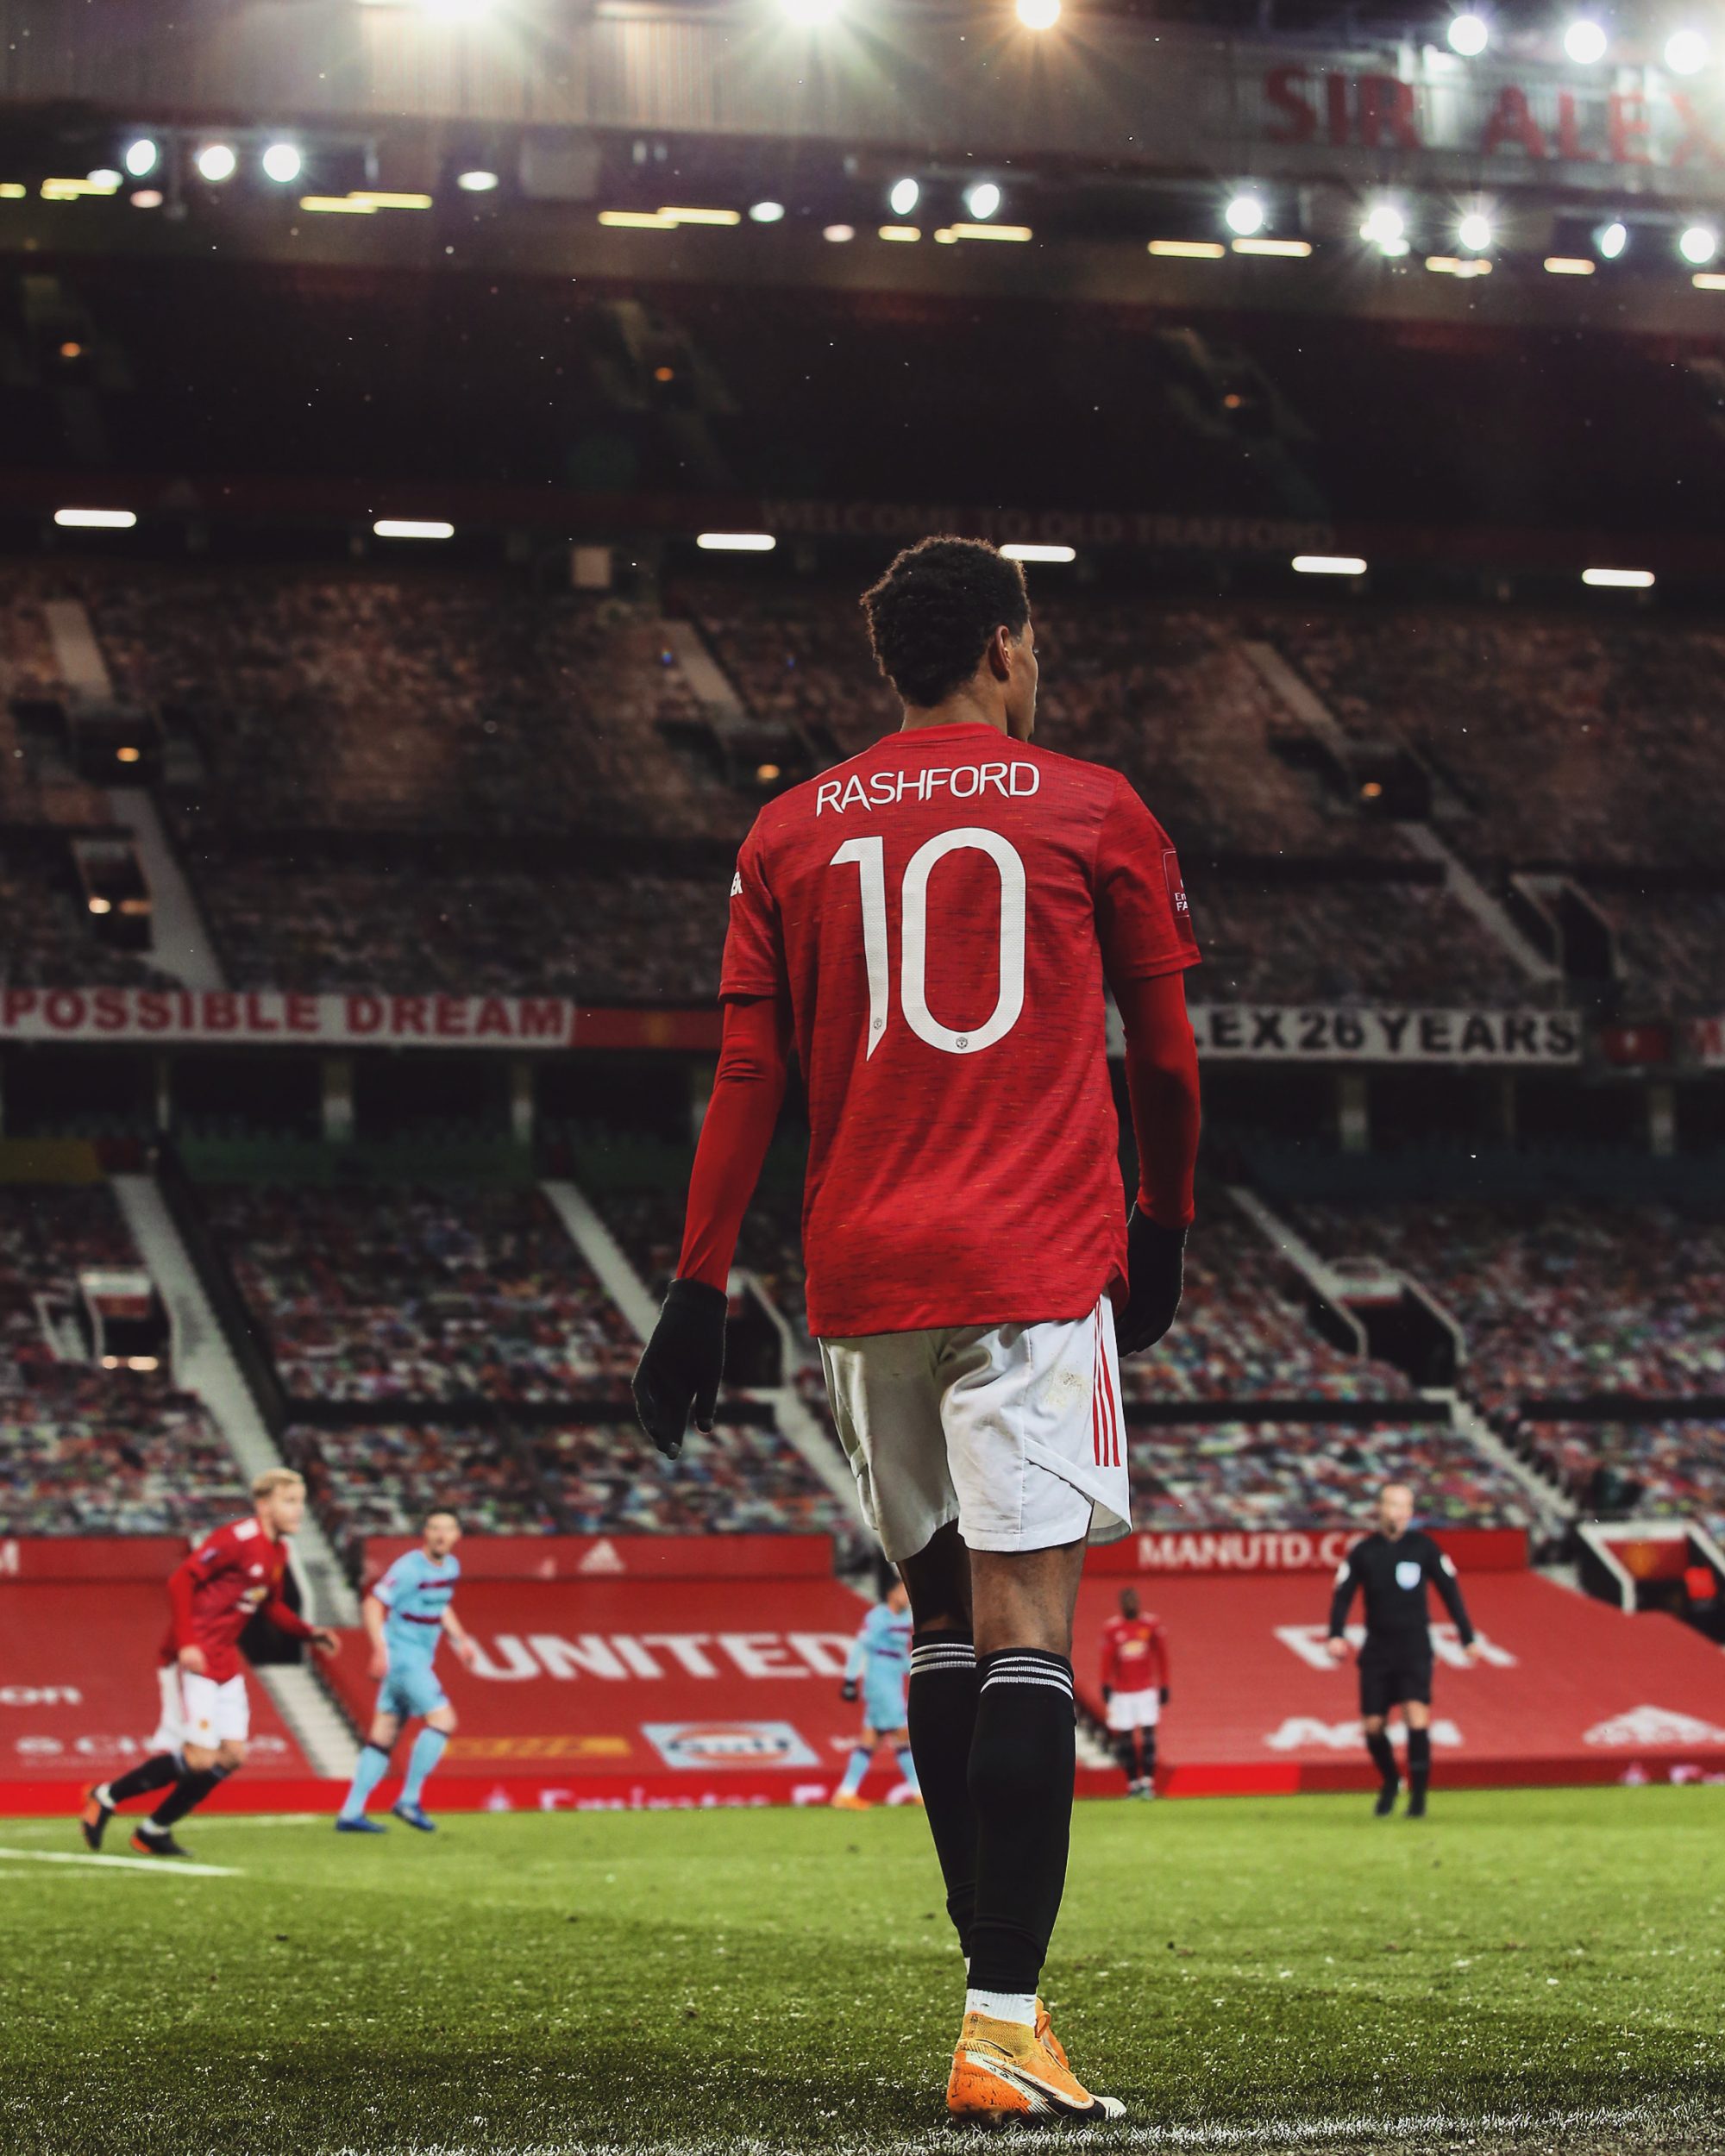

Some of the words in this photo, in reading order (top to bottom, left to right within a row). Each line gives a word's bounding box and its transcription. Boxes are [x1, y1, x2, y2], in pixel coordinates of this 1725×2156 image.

[1264, 66, 1421, 149] SIR
[1484, 85, 1725, 167] ALEX
[816, 761, 1040, 818] RASHFORD
[829, 827, 1026, 1062] 10
[3, 988, 323, 1032] POSSIBLE
[346, 995, 564, 1037] DREAM
[1377, 1012, 1576, 1056] YEARS
[467, 1633, 858, 1681] UNITED
